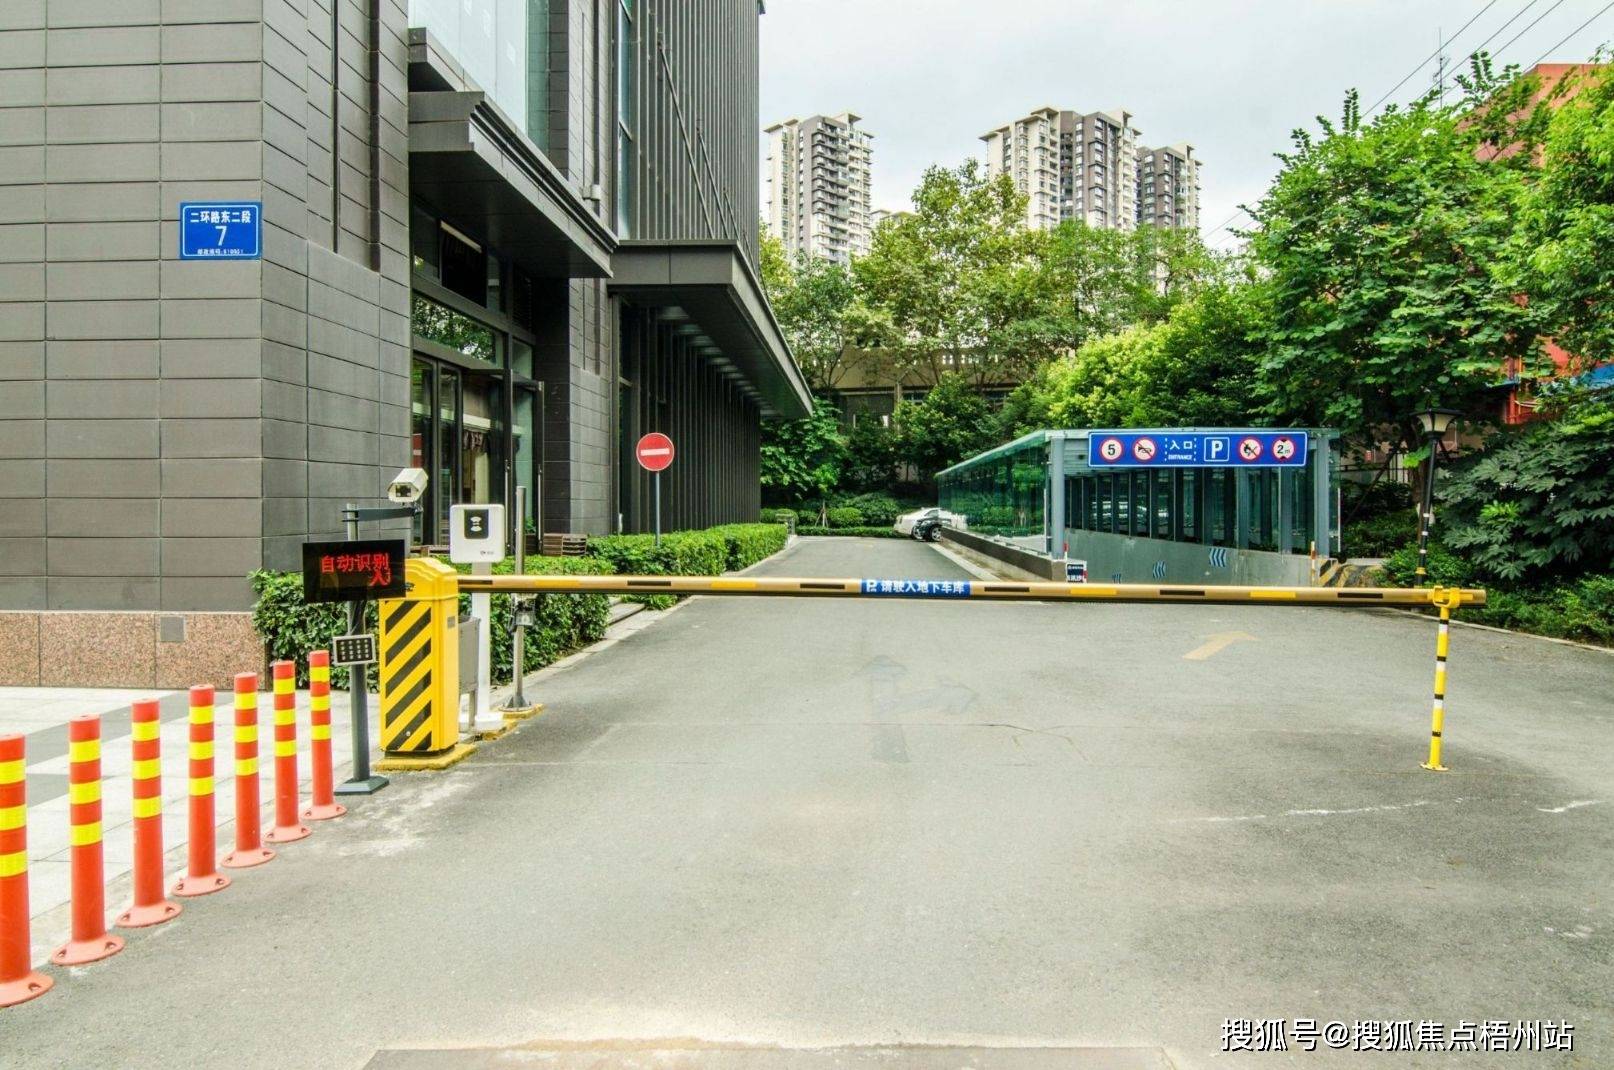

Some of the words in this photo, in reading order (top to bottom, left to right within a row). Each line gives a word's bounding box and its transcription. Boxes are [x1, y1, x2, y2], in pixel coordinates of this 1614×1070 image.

[190, 210, 252, 224] 二环路东二段
[215, 225, 227, 246] 7
[1107, 443, 1116, 456] 5
[1169, 439, 1193, 450] 入口
[1211, 440, 1224, 459] P
[321, 553, 389, 573] 自动识别
[880, 579, 965, 594] 请驶入地下车库
